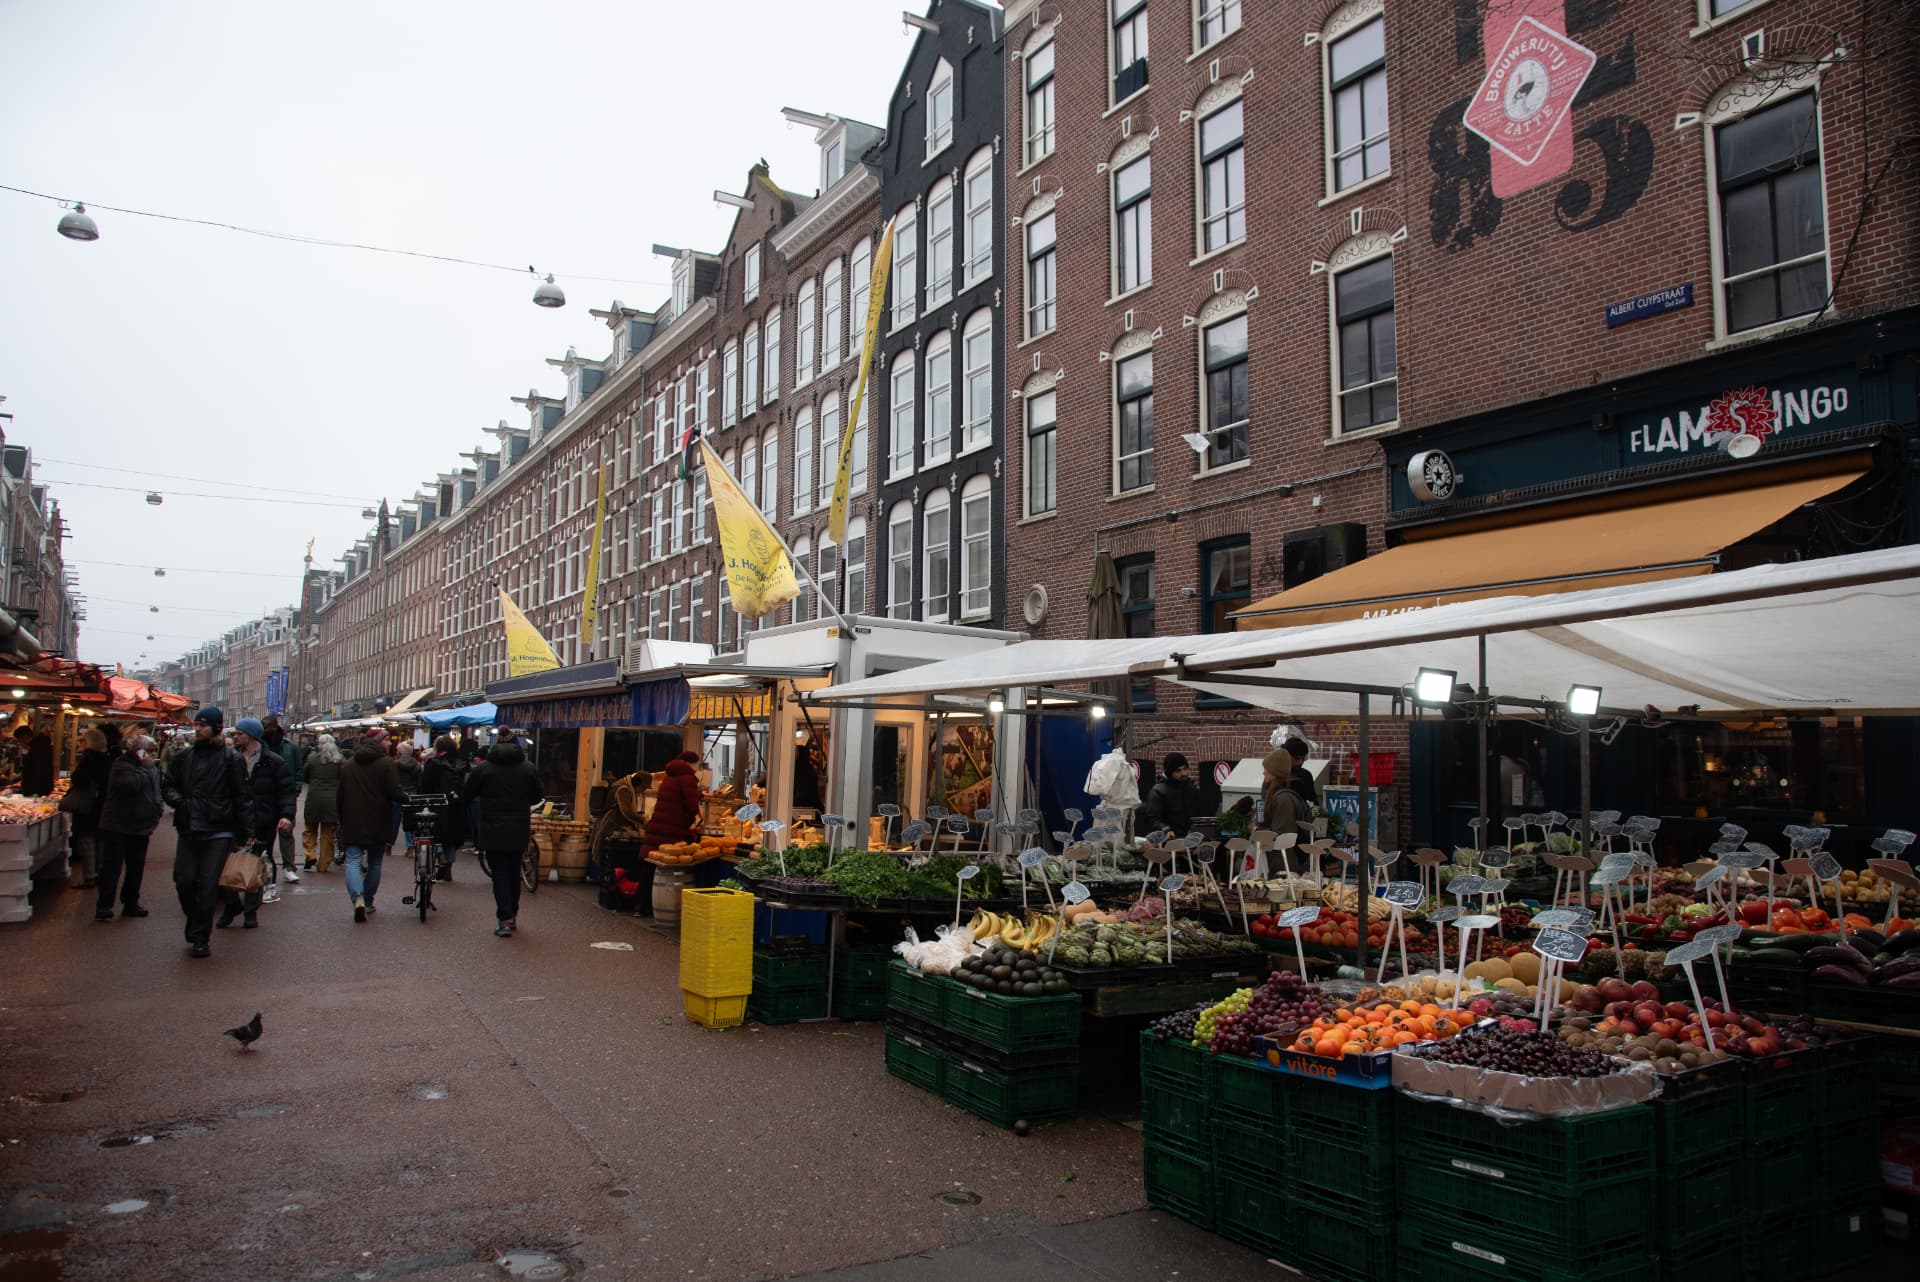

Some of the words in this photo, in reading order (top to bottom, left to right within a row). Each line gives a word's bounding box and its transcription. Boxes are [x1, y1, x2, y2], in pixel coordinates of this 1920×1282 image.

[1504, 105, 1553, 135] ZATTE
[1610, 301, 1635, 317] ALBERT
[1637, 286, 1685, 309] CUYPSTRAAT
[1432, 484, 1449, 496] Bier
